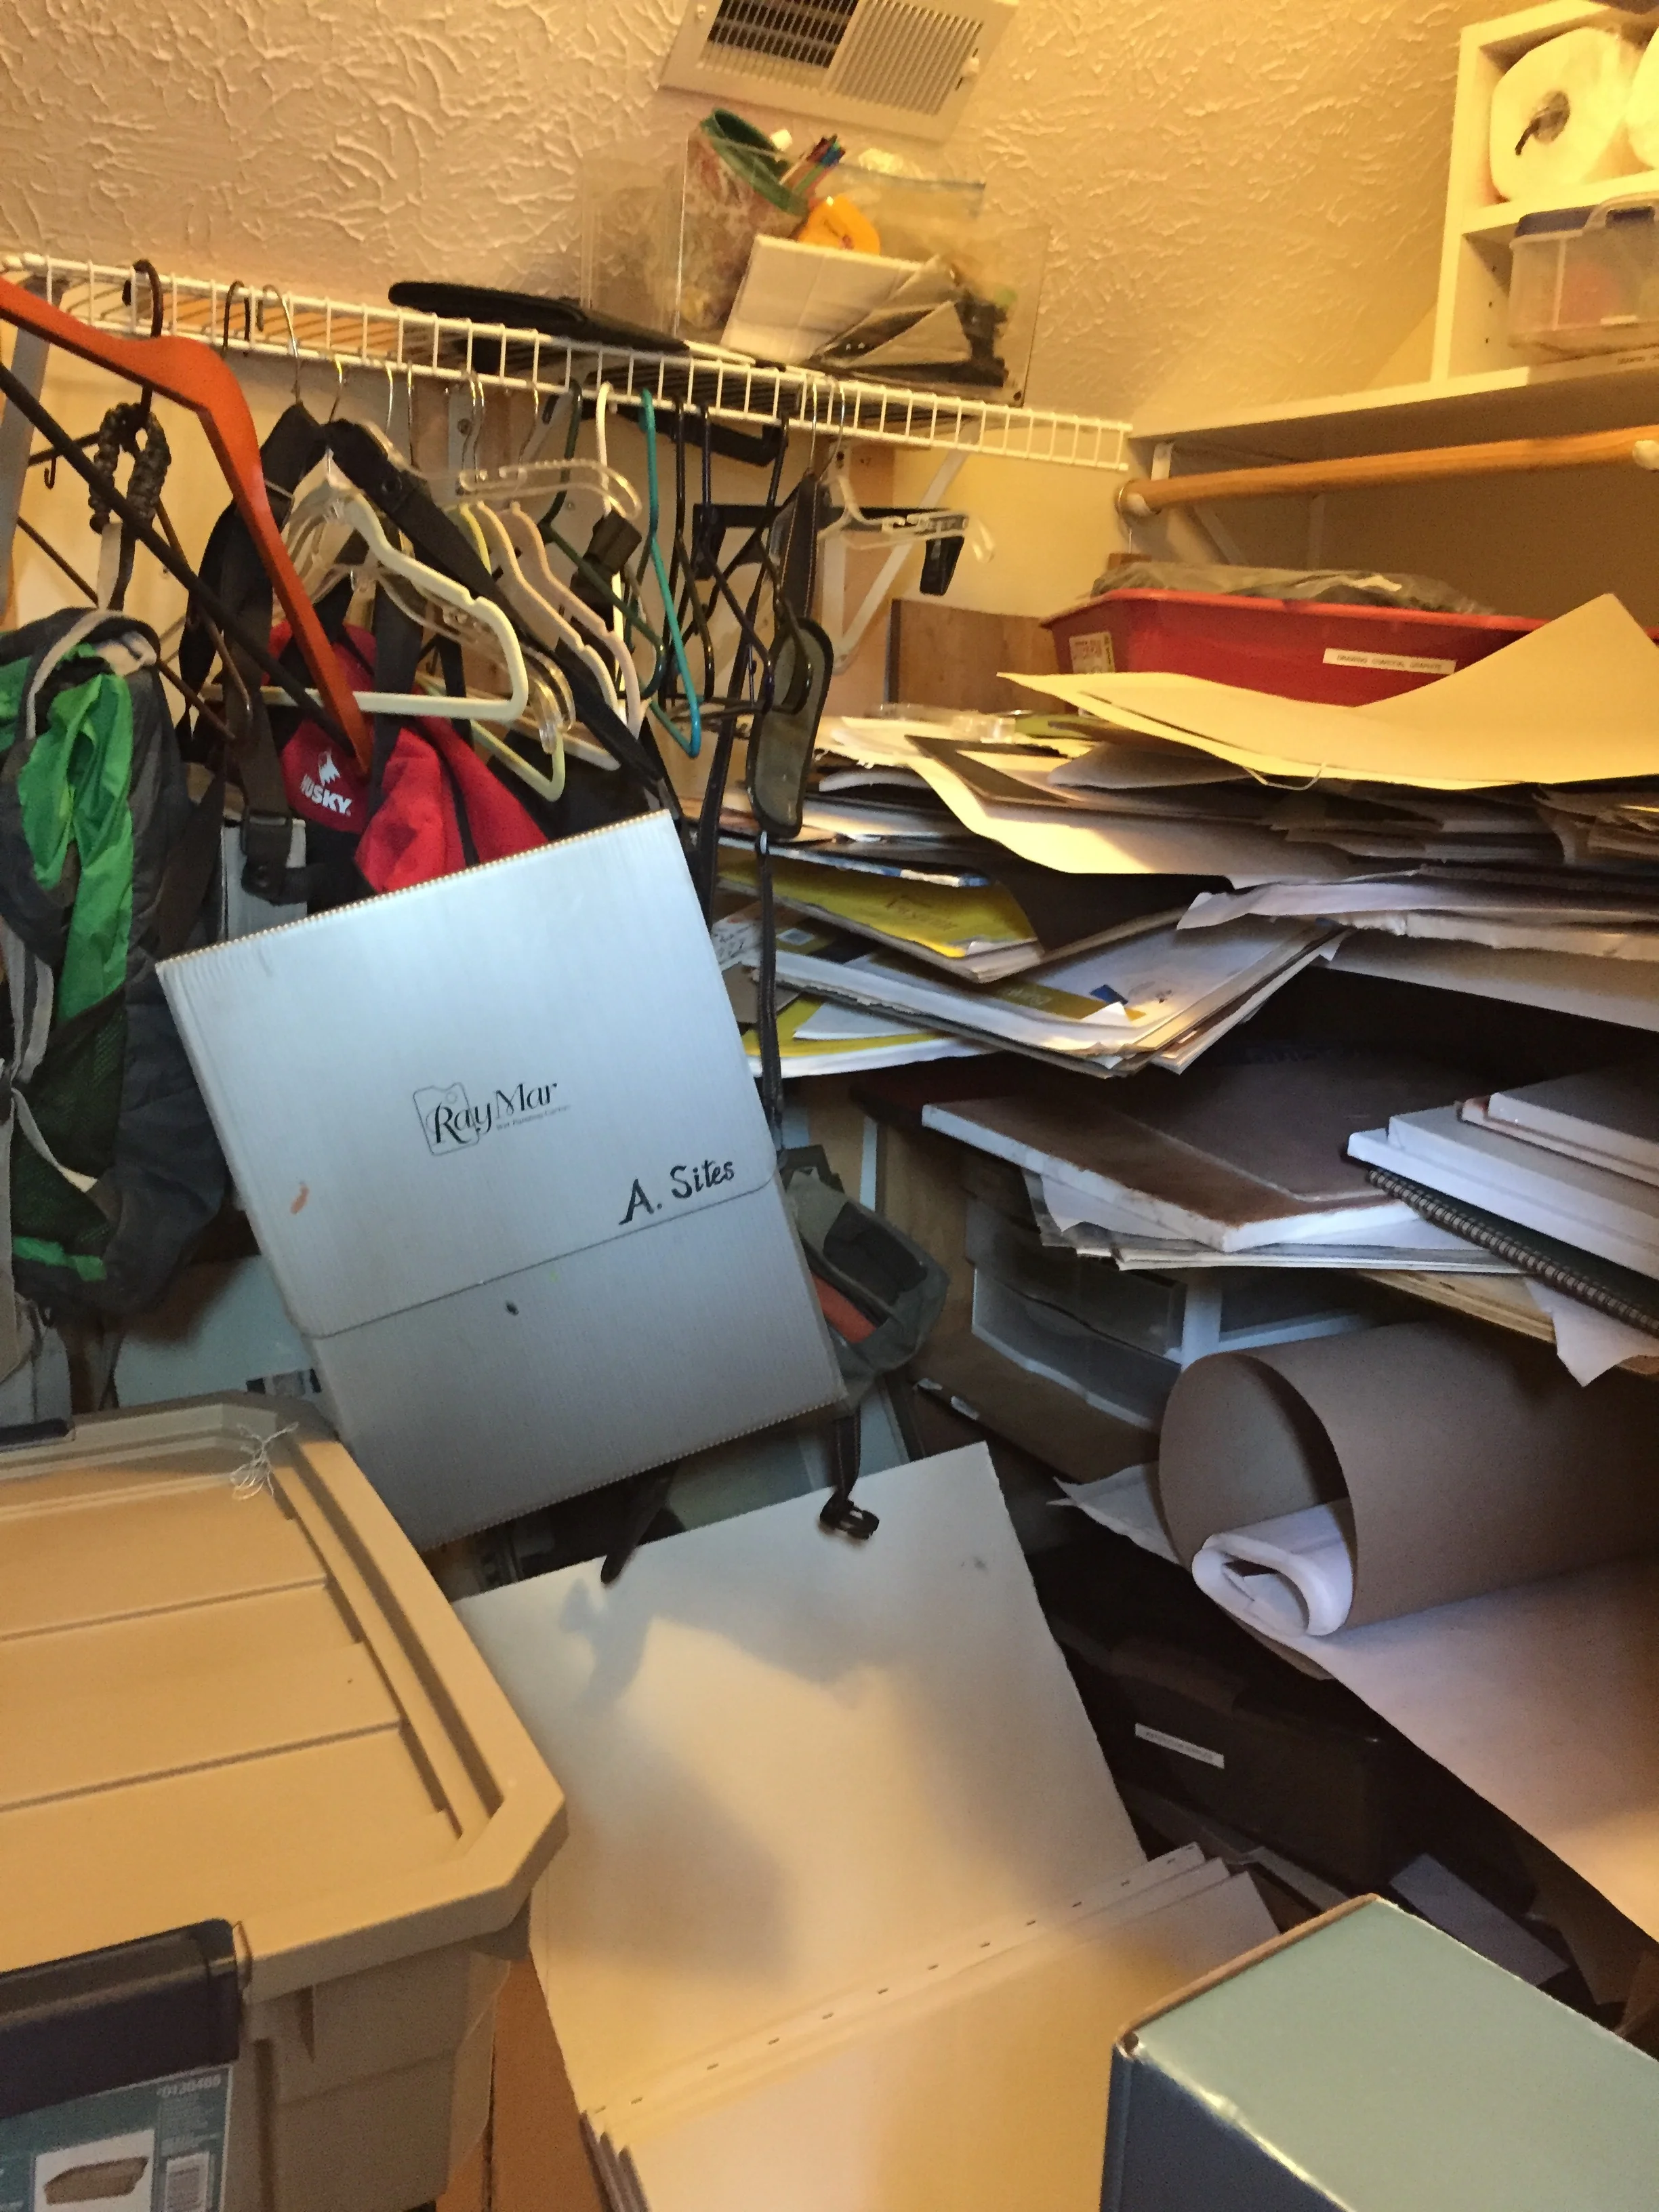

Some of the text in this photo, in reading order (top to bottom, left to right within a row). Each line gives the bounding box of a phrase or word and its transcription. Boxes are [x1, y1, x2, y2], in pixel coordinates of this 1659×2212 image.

[300, 773, 352, 816] HUSKY
[426, 1082, 558, 1145] RayMar
[619, 1159, 735, 1226] A. Sites
